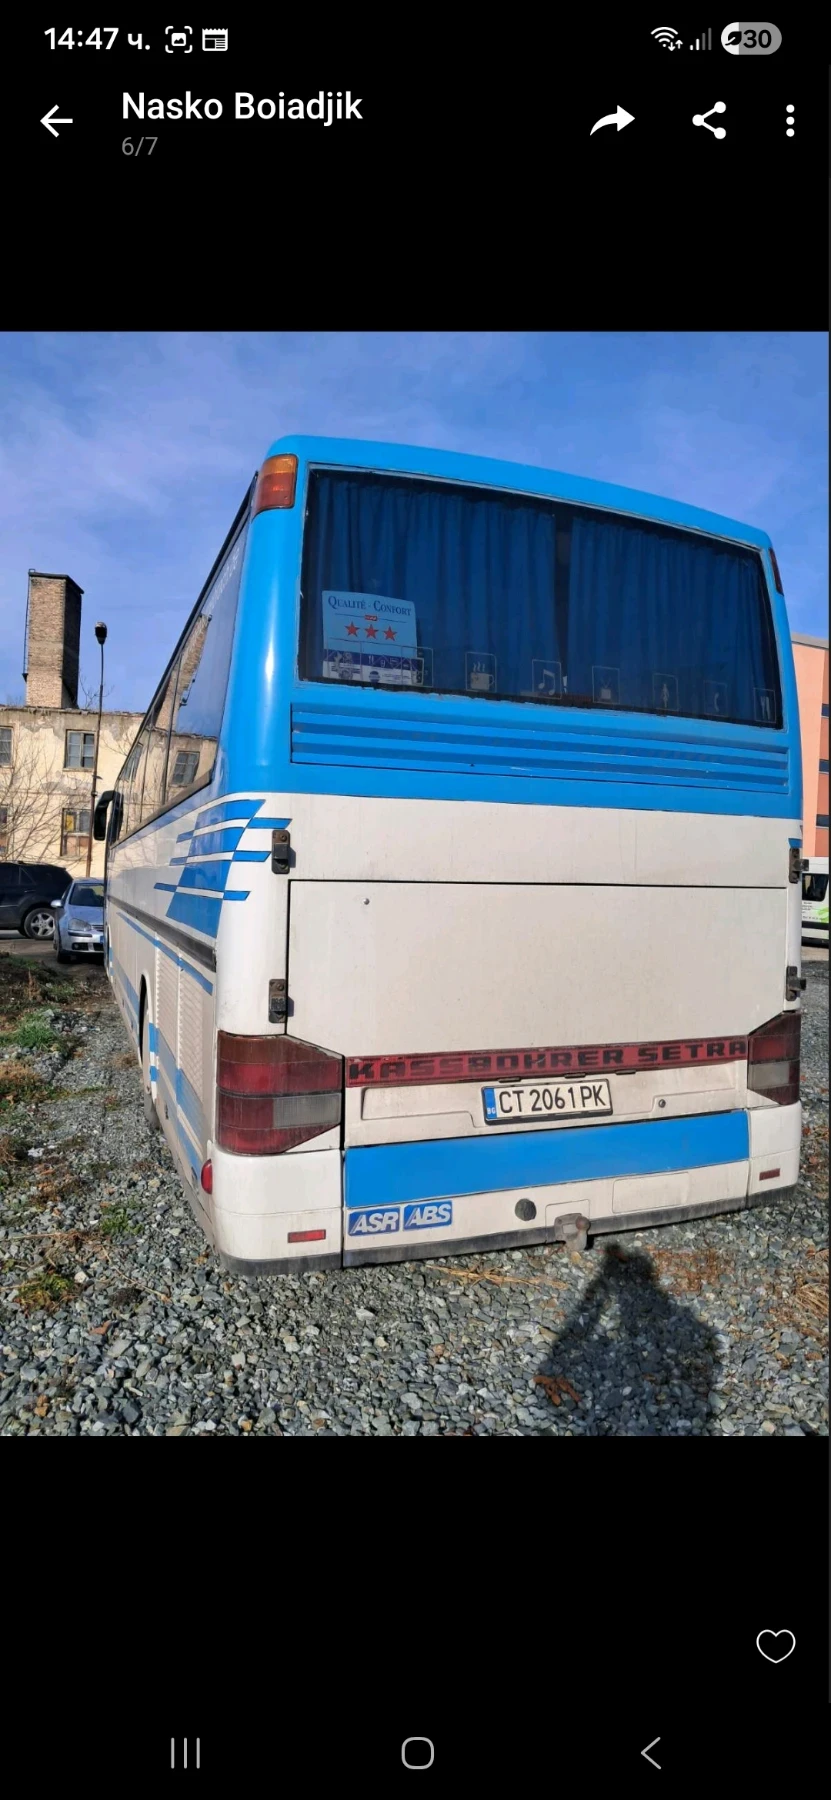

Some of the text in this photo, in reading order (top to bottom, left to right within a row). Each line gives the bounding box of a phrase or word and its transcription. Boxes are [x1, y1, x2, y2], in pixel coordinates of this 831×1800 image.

[638, 1040, 746, 1063] SETRA
[499, 1085, 606, 1113] CT 2061 PK
[350, 1211, 399, 1235] ASR
[405, 1203, 452, 1228] ABS
